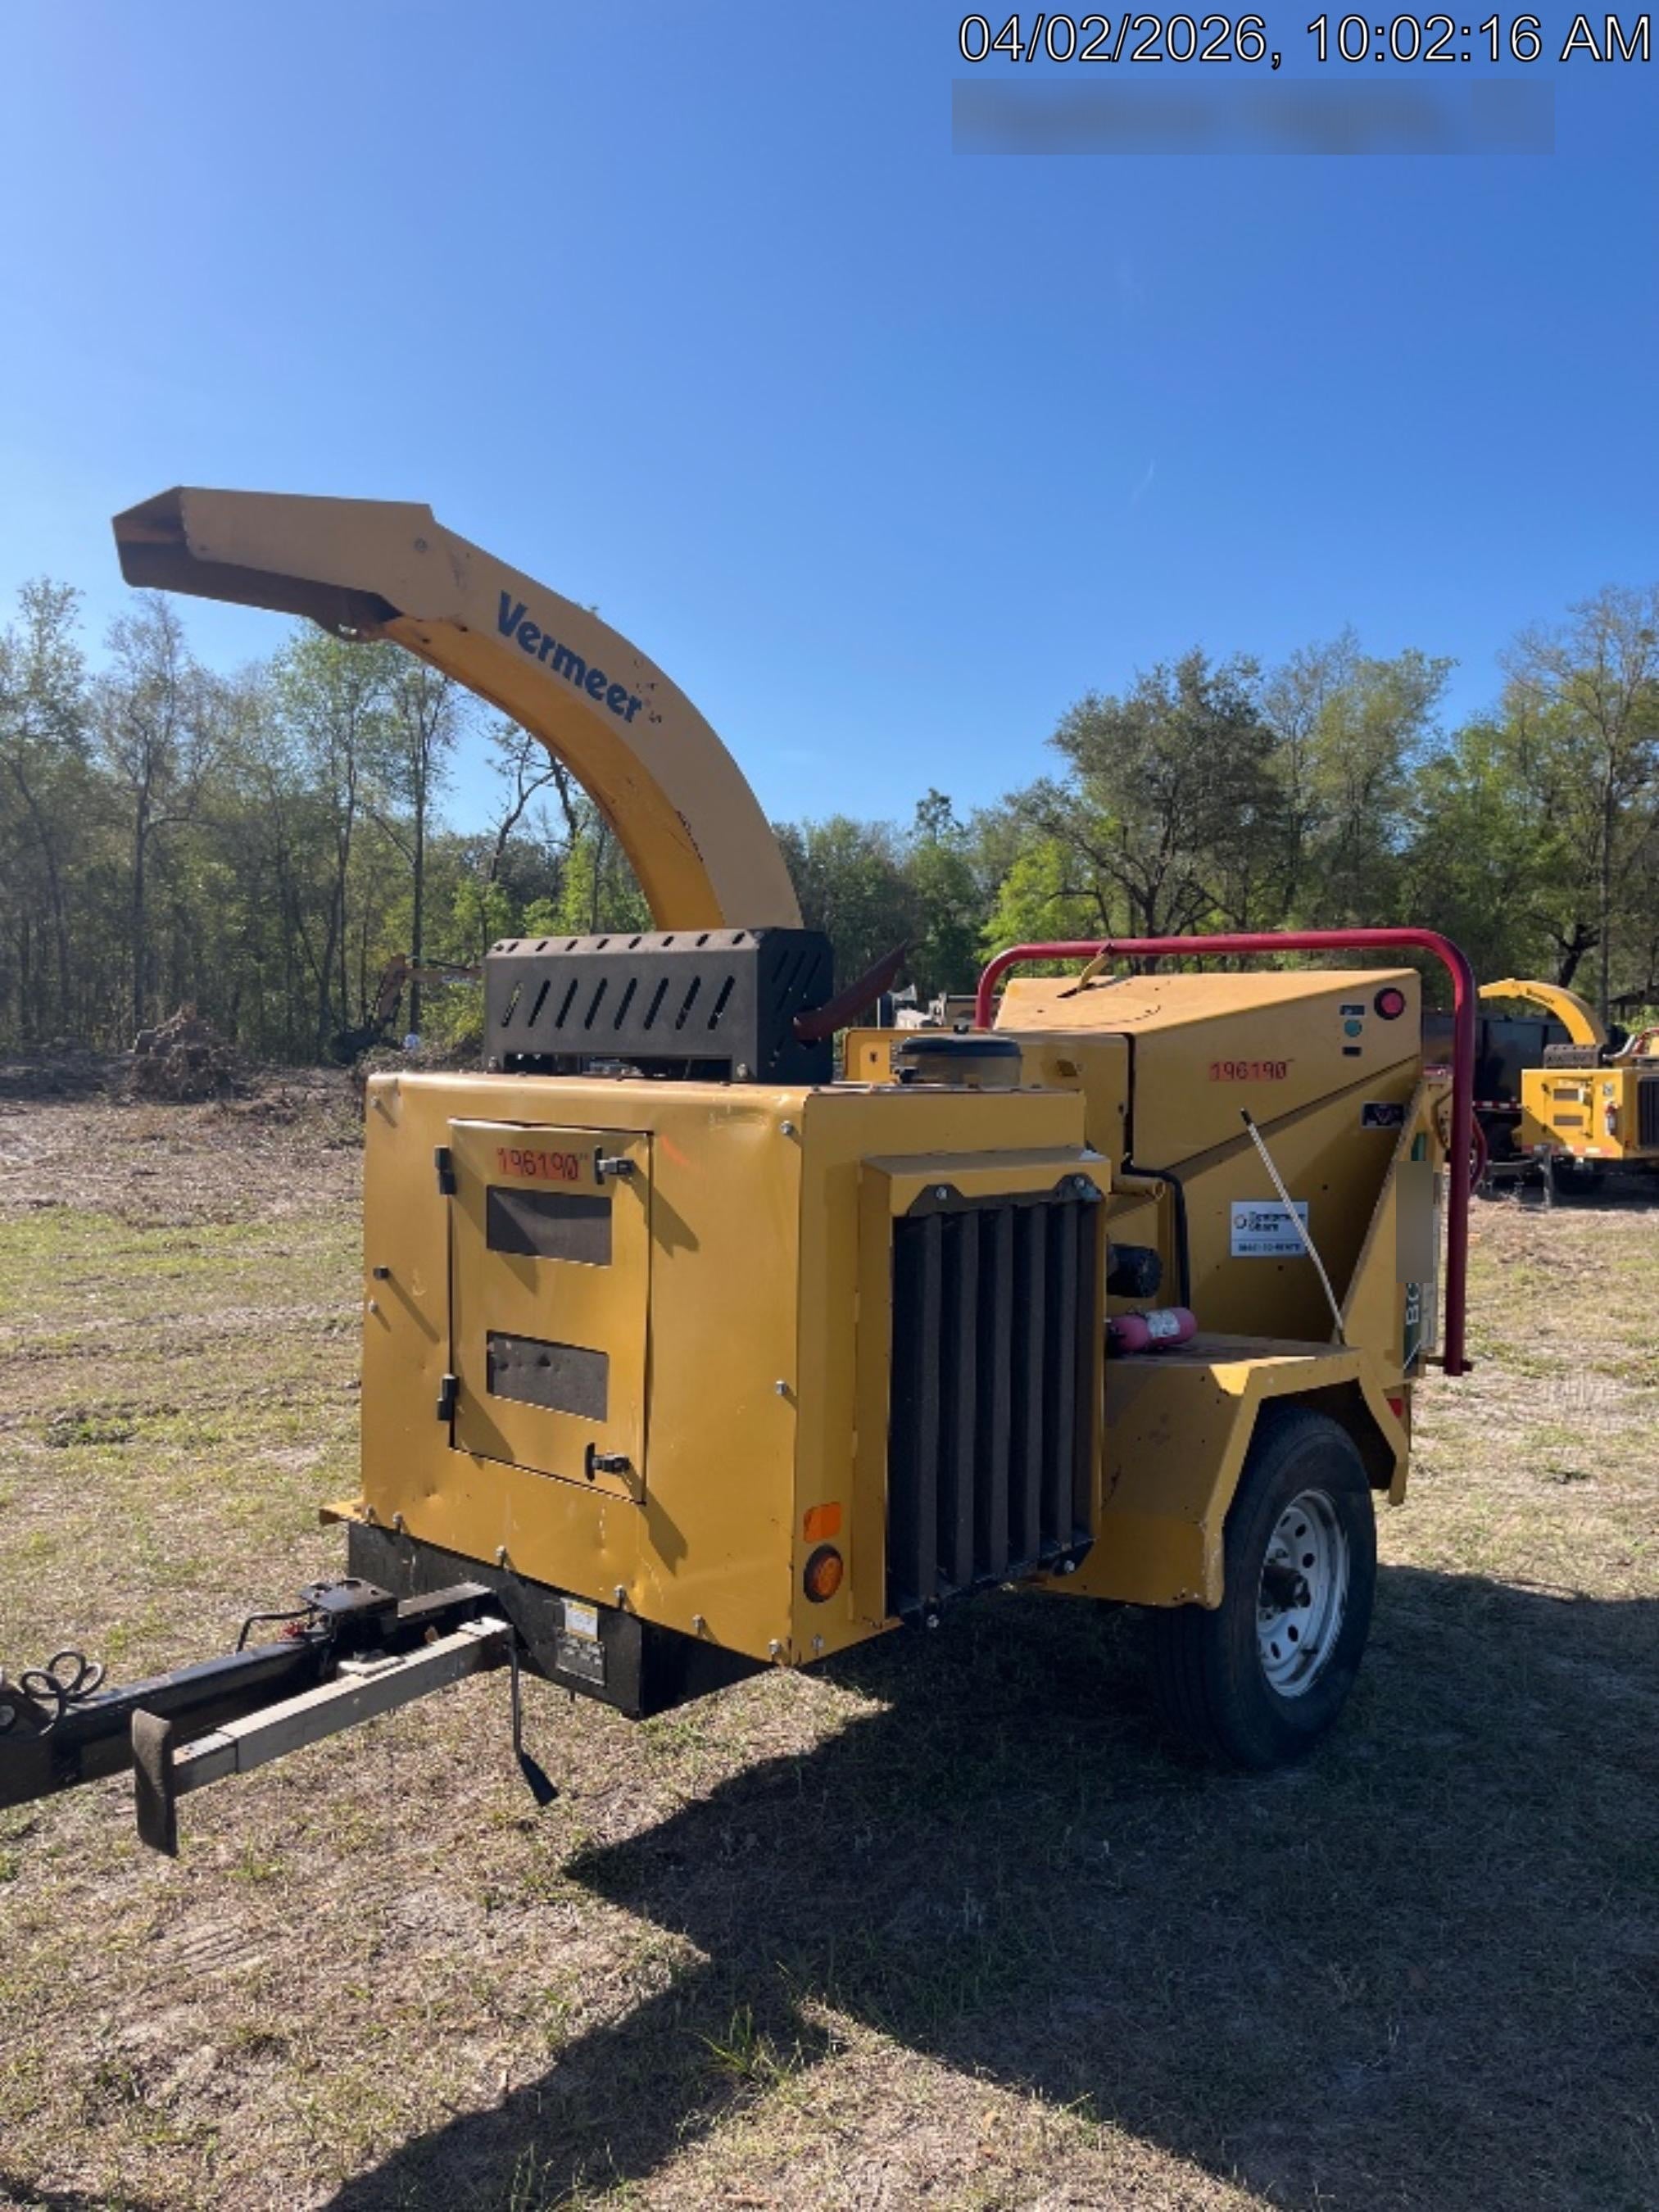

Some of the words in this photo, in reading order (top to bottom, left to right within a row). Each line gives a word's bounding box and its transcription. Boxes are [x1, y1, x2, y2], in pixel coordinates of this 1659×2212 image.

[498, 589, 642, 723] Vermeer
[1210, 1061, 1286, 1081] 196190
[497, 1147, 578, 1180] 196190
